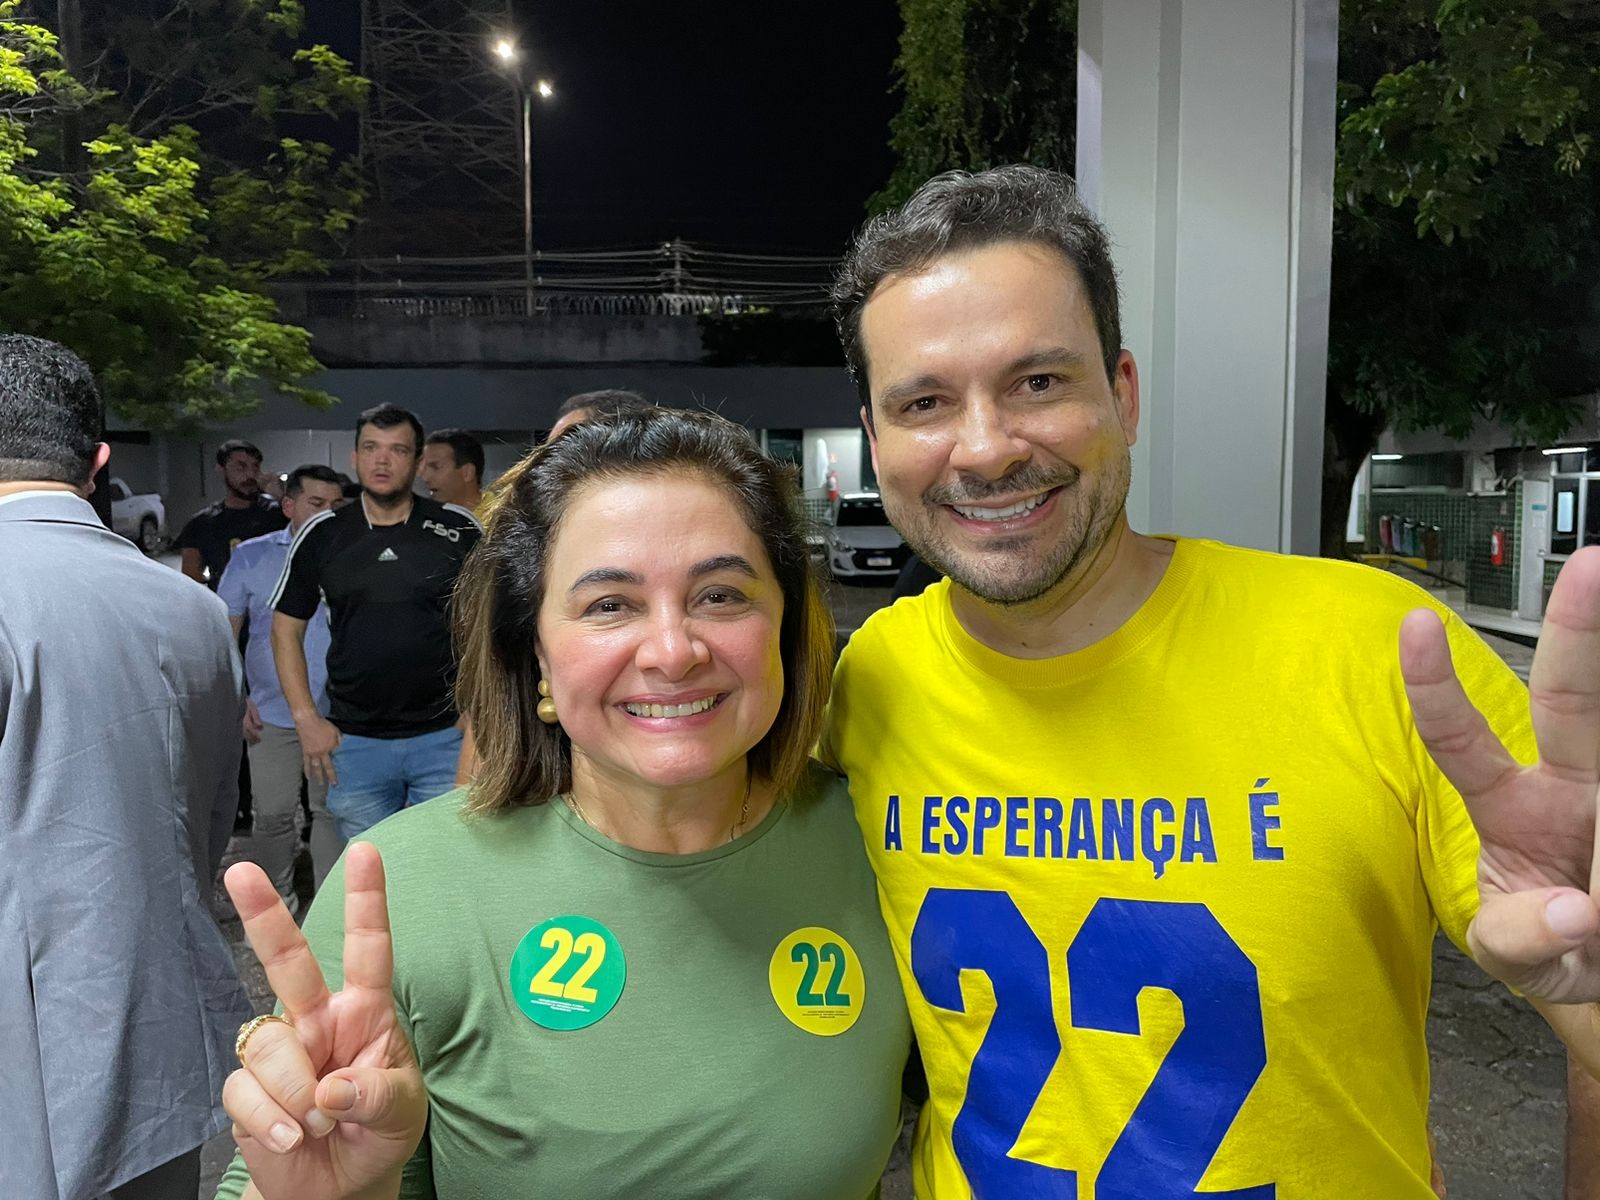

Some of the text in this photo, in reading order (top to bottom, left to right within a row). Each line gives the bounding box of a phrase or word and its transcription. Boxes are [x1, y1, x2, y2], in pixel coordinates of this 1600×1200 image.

[885, 777, 1285, 879] A ESPERANÇA É
[529, 927, 606, 1003] 22
[791, 942, 851, 1006] 22
[911, 887, 1276, 1200] 22
